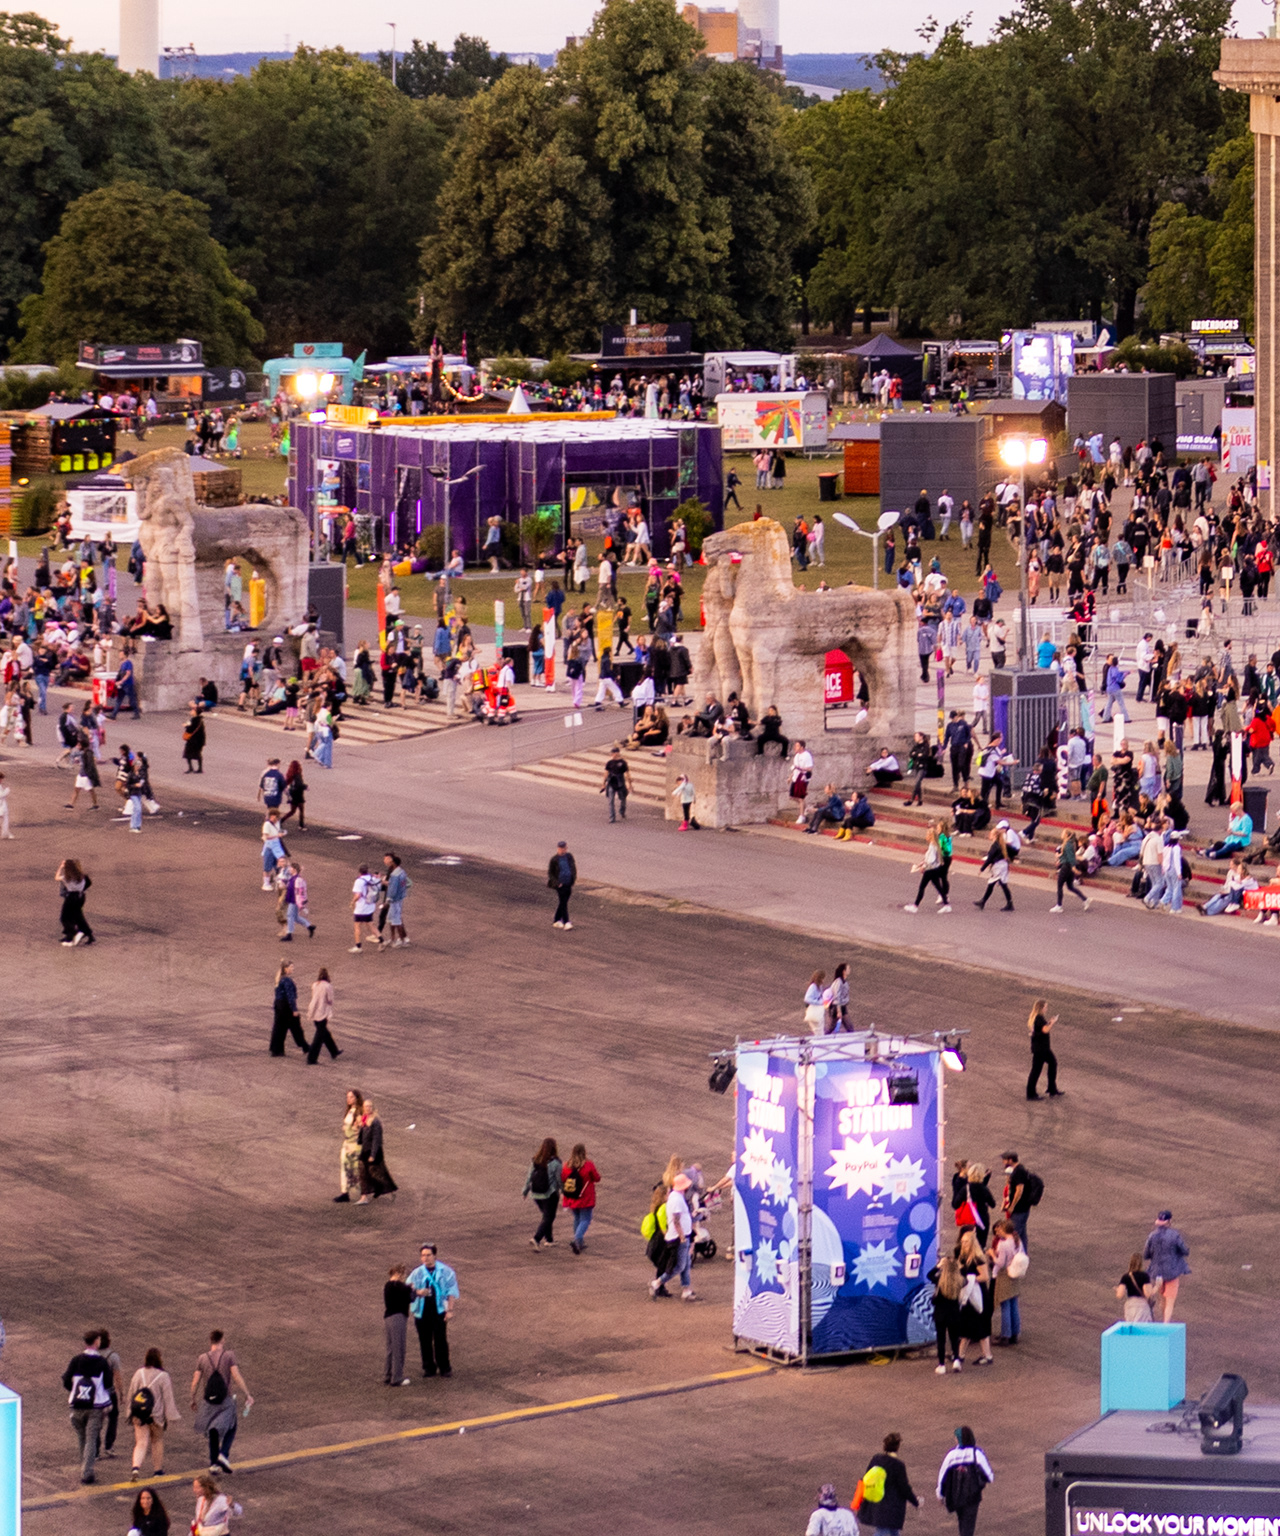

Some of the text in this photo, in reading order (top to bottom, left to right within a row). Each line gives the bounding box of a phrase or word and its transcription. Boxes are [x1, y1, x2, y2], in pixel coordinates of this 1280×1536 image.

[1231, 434, 1251, 446] LOVE
[826, 673, 842, 690] ICE
[845, 1078, 881, 1107] TOP
[838, 1104, 913, 1135] STATION
[845, 1161, 878, 1173] PayPal
[1076, 1512, 1153, 1534] UNLOCK
[1153, 1514, 1205, 1535] YOUR
